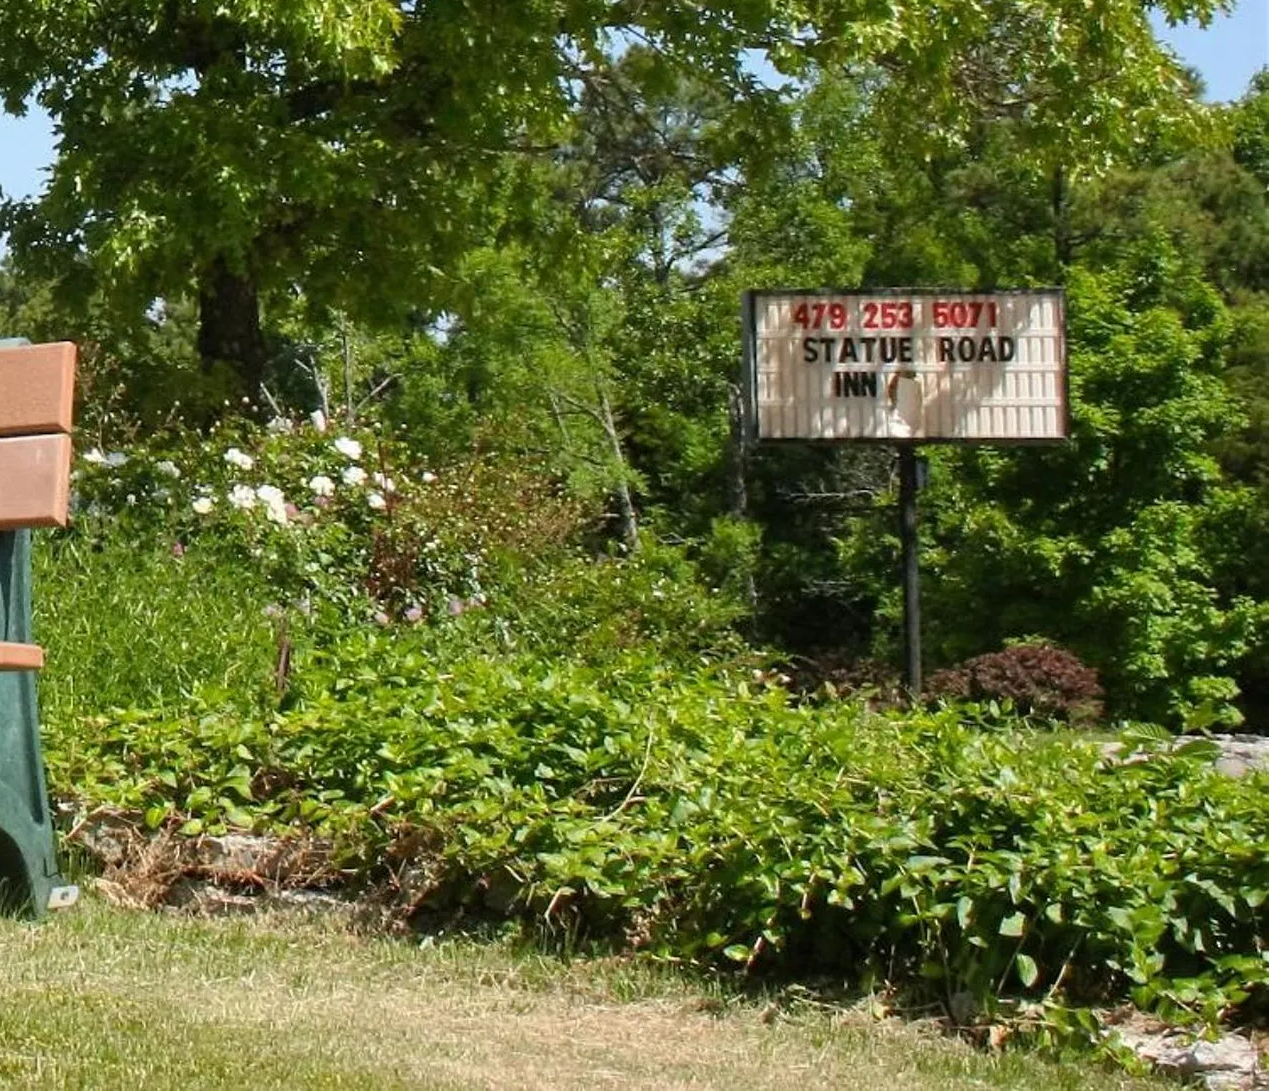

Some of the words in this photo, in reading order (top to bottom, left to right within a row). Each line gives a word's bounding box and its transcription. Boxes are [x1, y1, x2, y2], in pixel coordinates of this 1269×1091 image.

[792, 302, 847, 329] 479
[863, 302, 913, 329] 253
[803, 337, 913, 364] STATUE
[939, 336, 1016, 363] ROAD
[834, 371, 877, 398] INN
